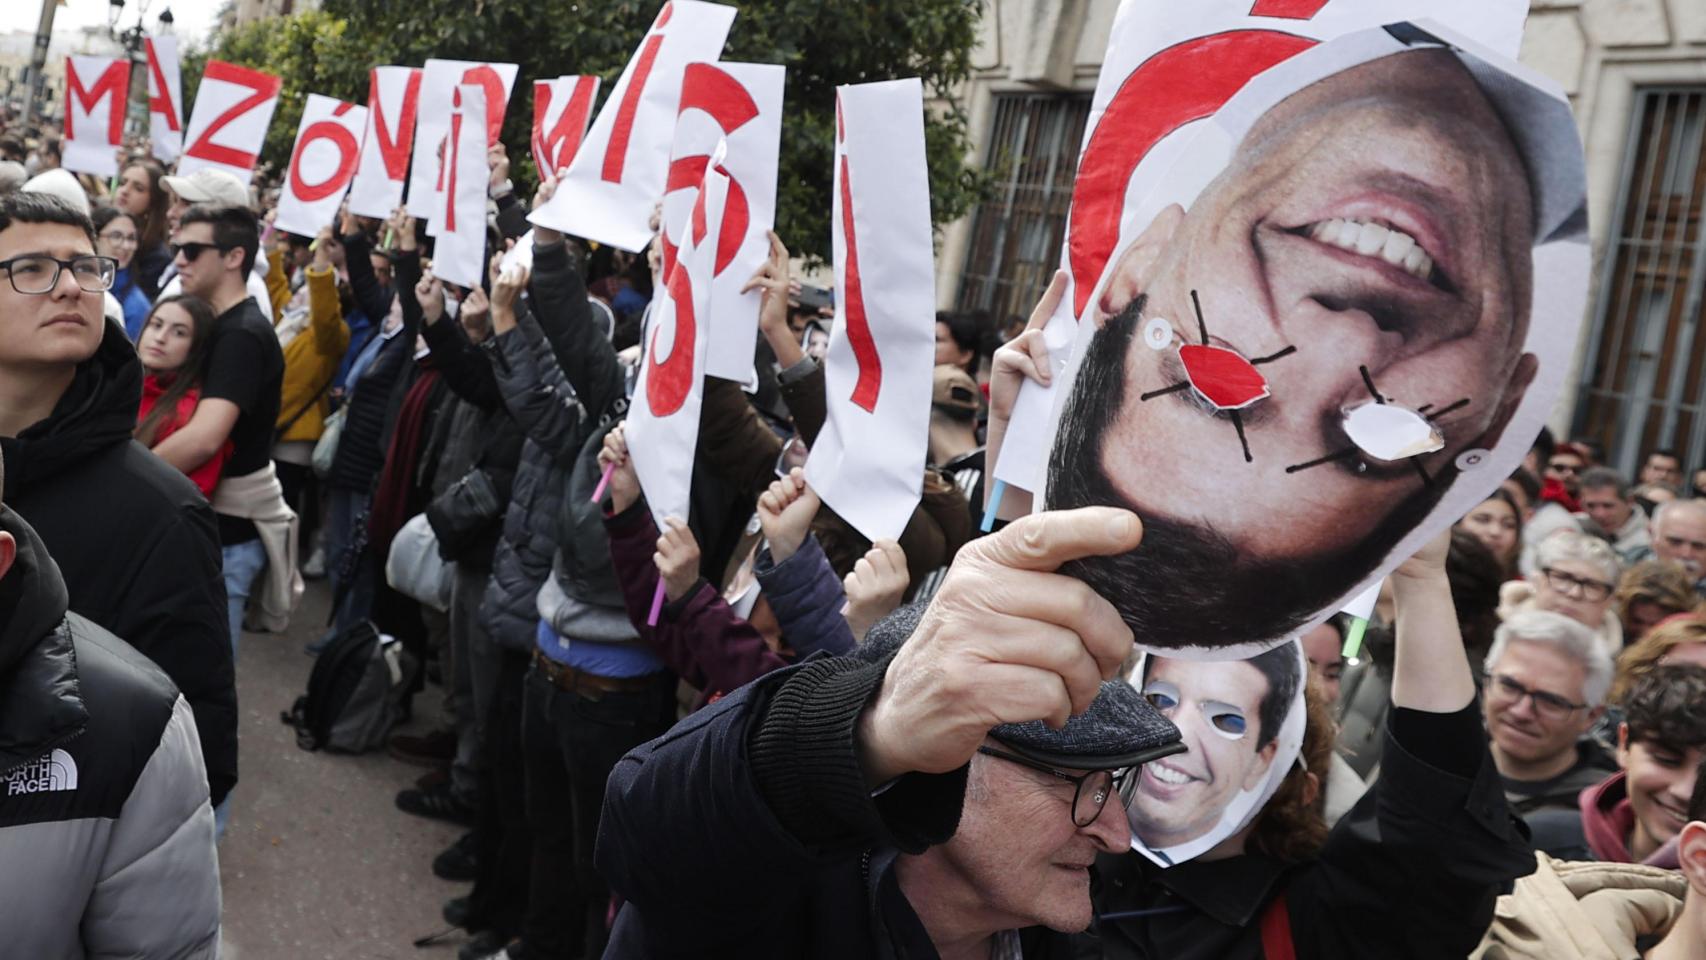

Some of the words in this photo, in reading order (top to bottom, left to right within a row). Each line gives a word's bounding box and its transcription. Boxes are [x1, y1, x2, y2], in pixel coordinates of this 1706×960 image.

[63, 37, 423, 201] MAZÓN
[0, 763, 50, 783] ORTH
[8, 778, 49, 796] FACE
